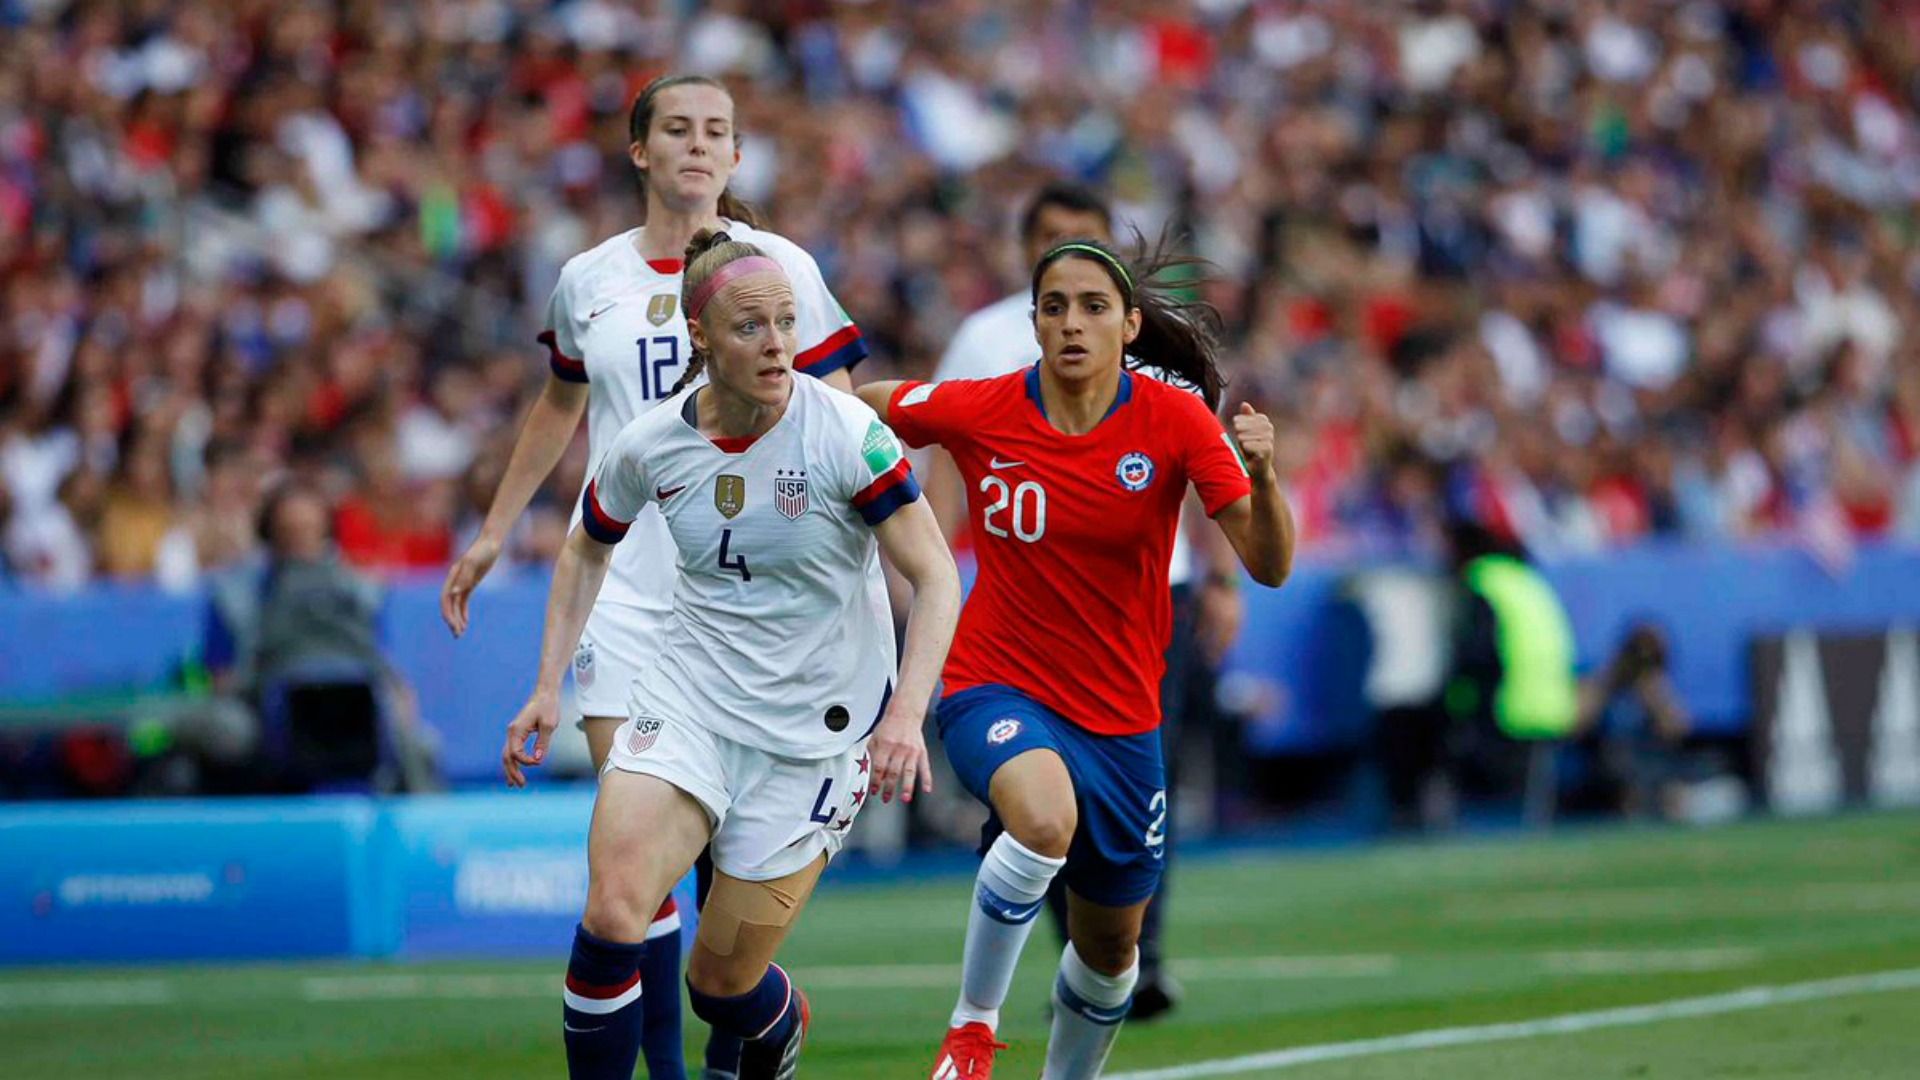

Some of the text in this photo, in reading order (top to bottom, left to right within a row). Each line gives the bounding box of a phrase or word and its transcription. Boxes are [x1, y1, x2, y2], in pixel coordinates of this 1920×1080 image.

[636, 336, 678, 400] 12
[777, 481, 805, 498] USA
[980, 474, 1046, 543] 20
[718, 529, 751, 582] 4
[636, 719, 660, 735] USA
